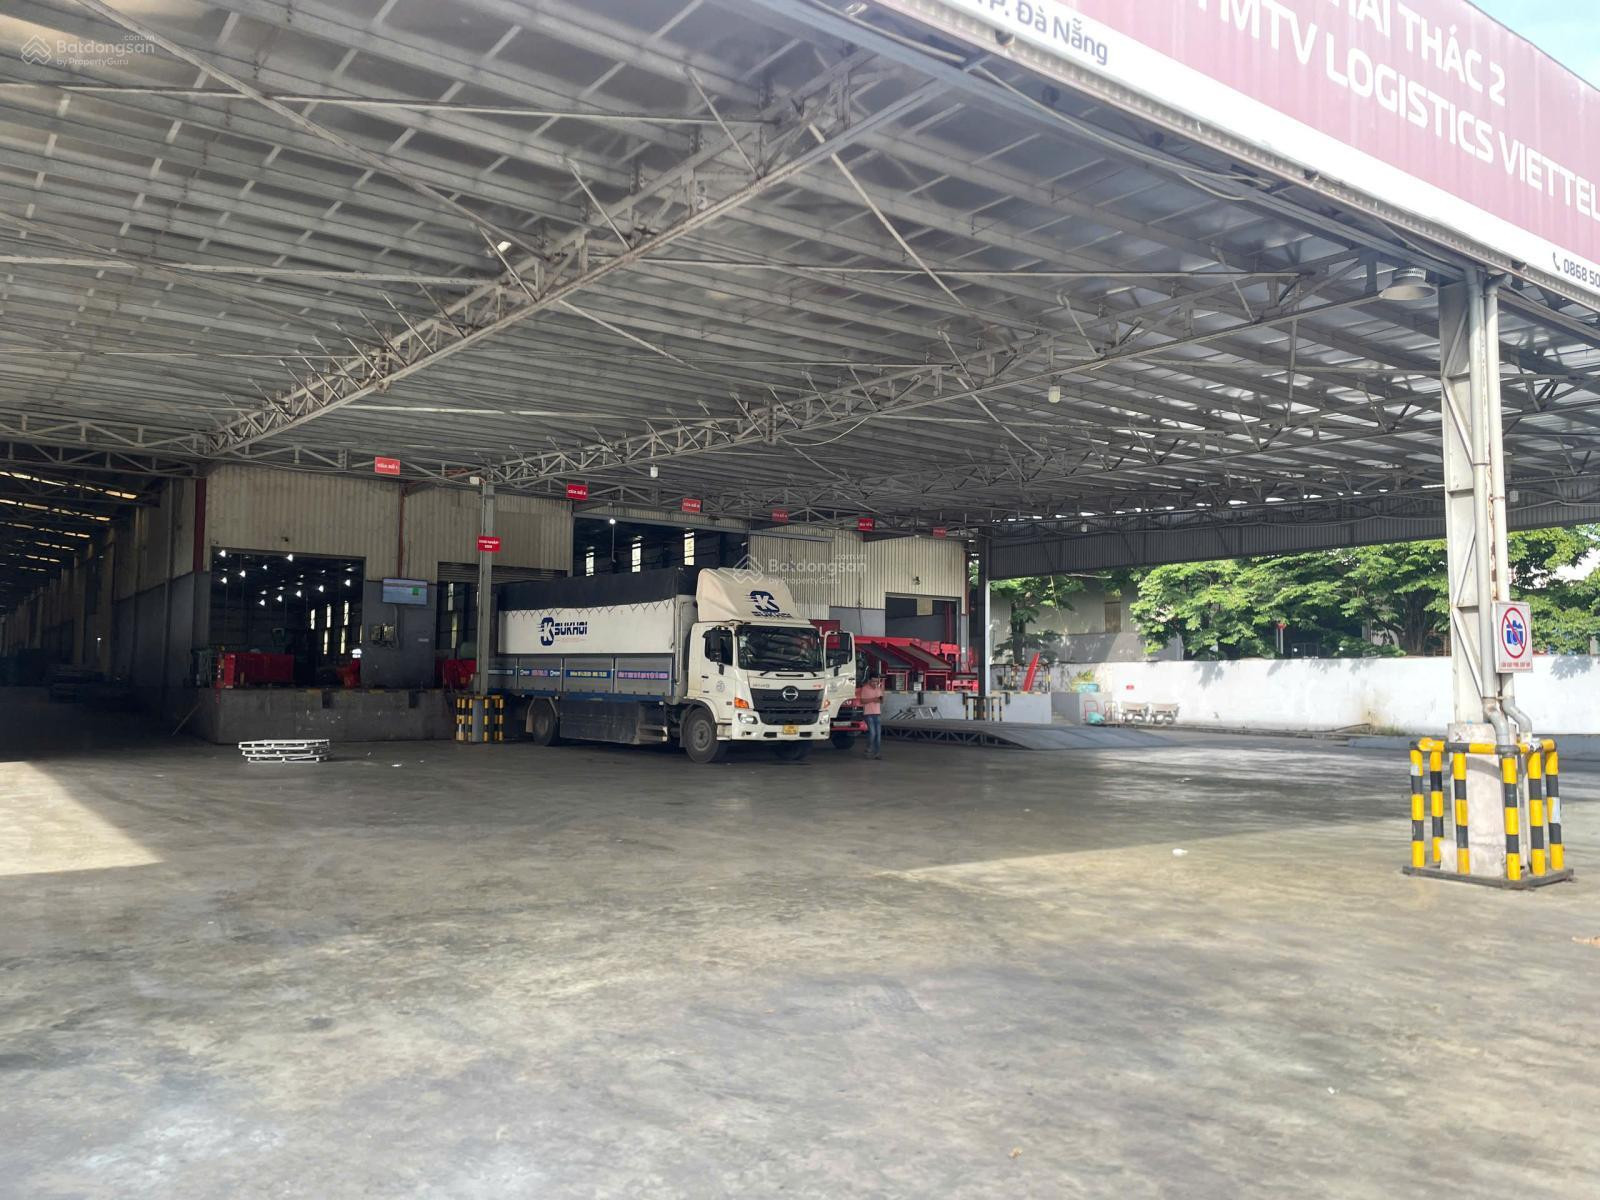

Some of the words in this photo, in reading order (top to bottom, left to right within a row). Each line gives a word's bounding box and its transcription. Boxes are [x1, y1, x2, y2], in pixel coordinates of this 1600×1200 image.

[1015, 0, 1047, 33] Đà
[1053, 15, 1108, 66] Nẵng
[1400, 9, 1483, 94] THÁC
[1488, 60, 1506, 108] 2
[1325, 31, 1493, 164] LOGISTICS
[1498, 130, 1600, 223] VIETTEL
[1563, 258, 1587, 282] 0868
[554, 621, 588, 636] SUKHOI
